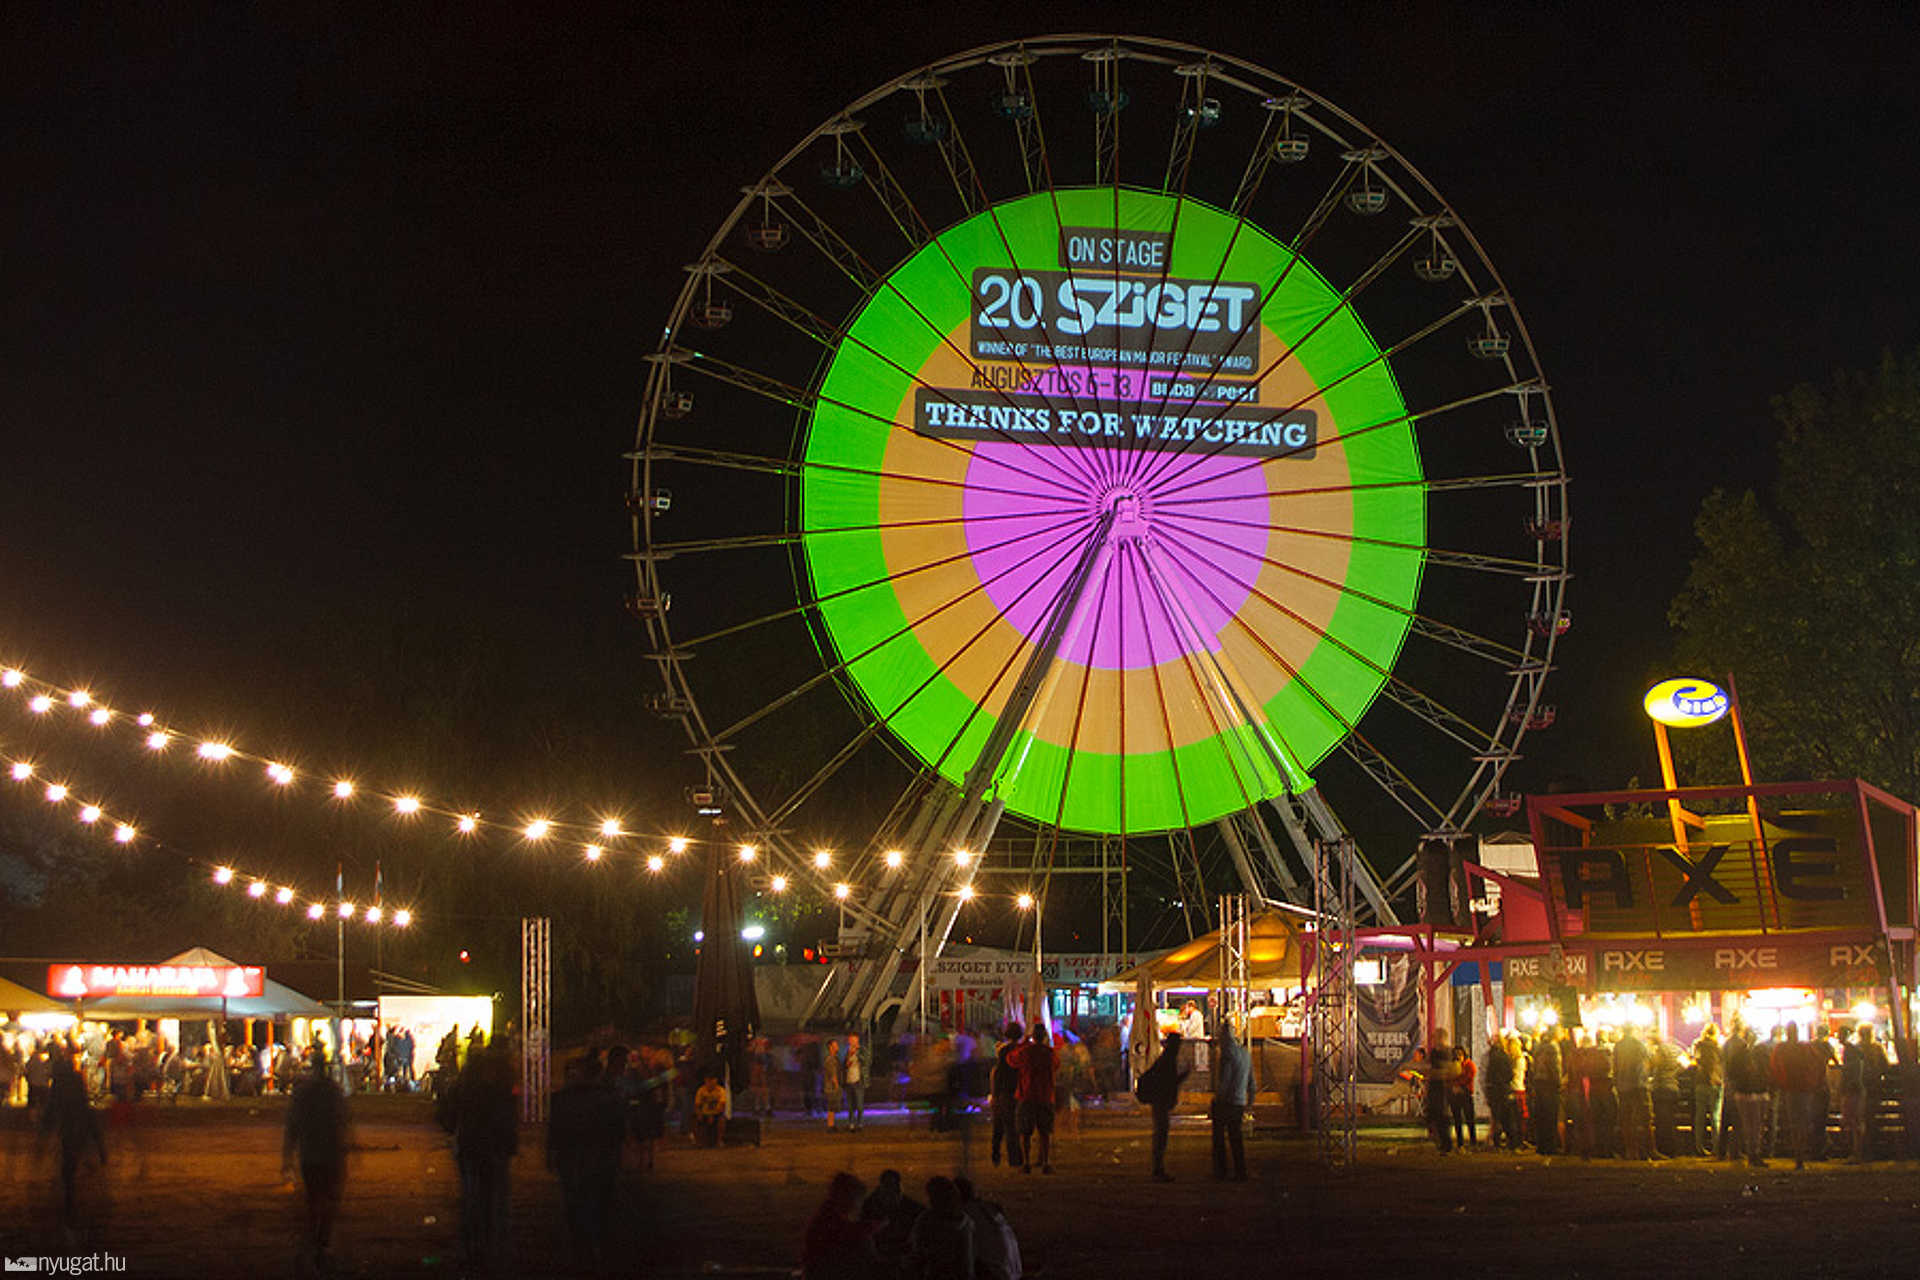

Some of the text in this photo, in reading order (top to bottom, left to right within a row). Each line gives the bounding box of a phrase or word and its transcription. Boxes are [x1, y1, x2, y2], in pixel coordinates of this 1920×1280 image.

[1068, 237, 1164, 267] ON STAGE
[1015, 343, 1028, 356] OF
[1054, 345, 1080, 359] BEST
[1081, 347, 1131, 363] EUROPEAN
[970, 365, 1081, 393] AUGUSZTUS
[925, 402, 1308, 447] THANKS FOR WATCHING
[1560, 837, 1845, 910] AXE
[1509, 958, 1540, 978] AXE
[1603, 944, 1876, 971] AXE AXE AX
